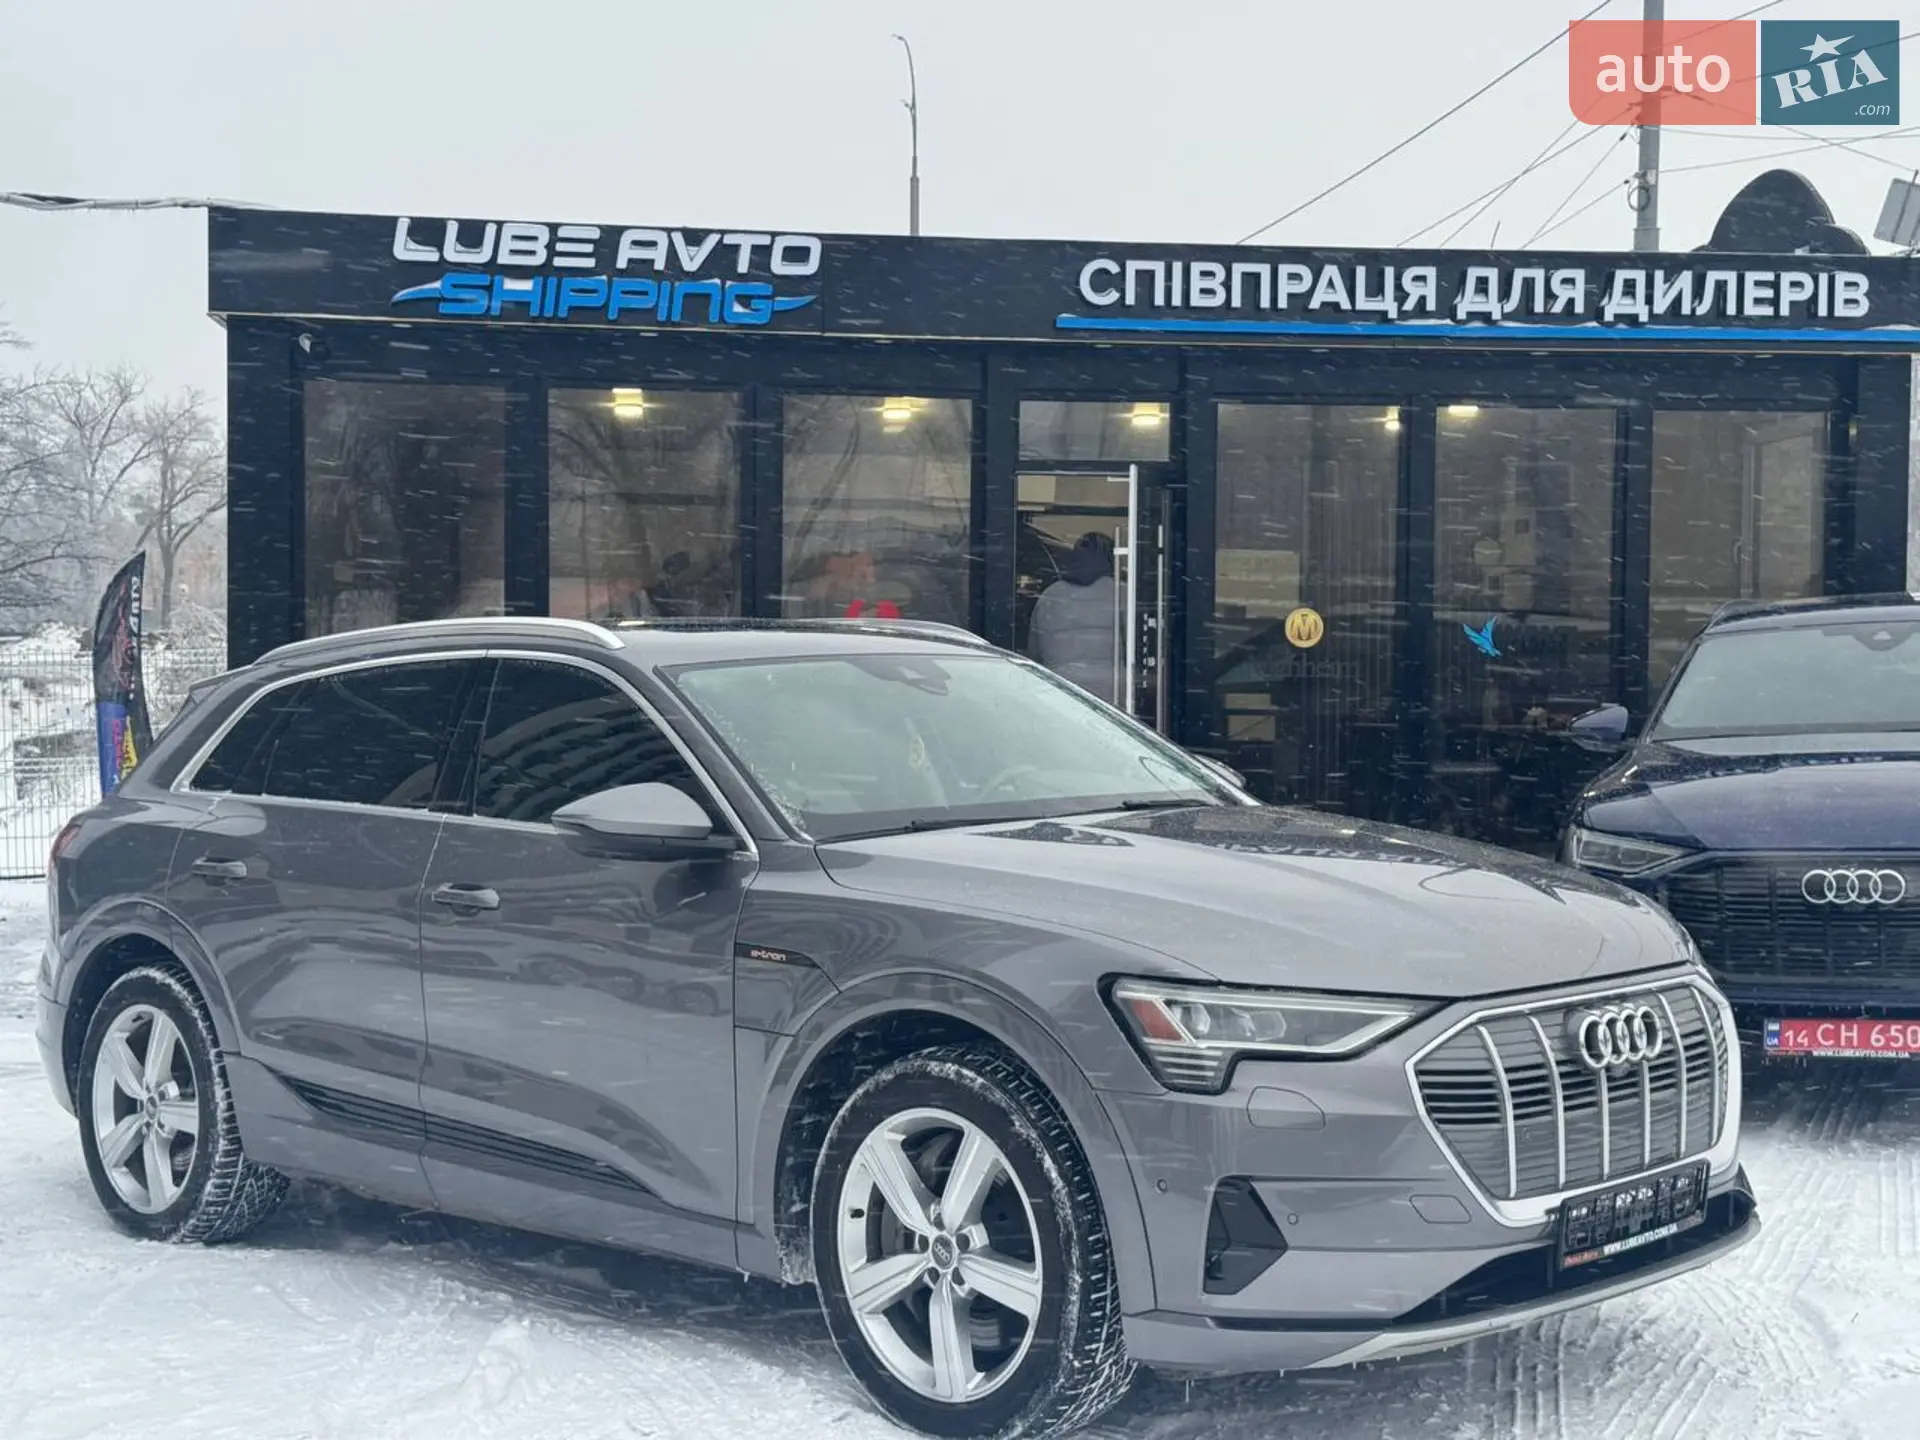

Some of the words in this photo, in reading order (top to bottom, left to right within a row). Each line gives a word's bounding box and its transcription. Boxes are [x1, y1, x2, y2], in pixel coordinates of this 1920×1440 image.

[392, 216, 601, 269] LUBE
[615, 228, 822, 275] AVTO
[438, 272, 775, 325] SHIPPING
[1078, 258, 1437, 320] СПІВПРАЦЯ
[1455, 266, 1586, 321] ДЛЯ
[1602, 268, 1871, 322] ДИЛЕРІВ
[1784, 1030, 1809, 1047] 14
[1816, 1023, 1858, 1047] CH
